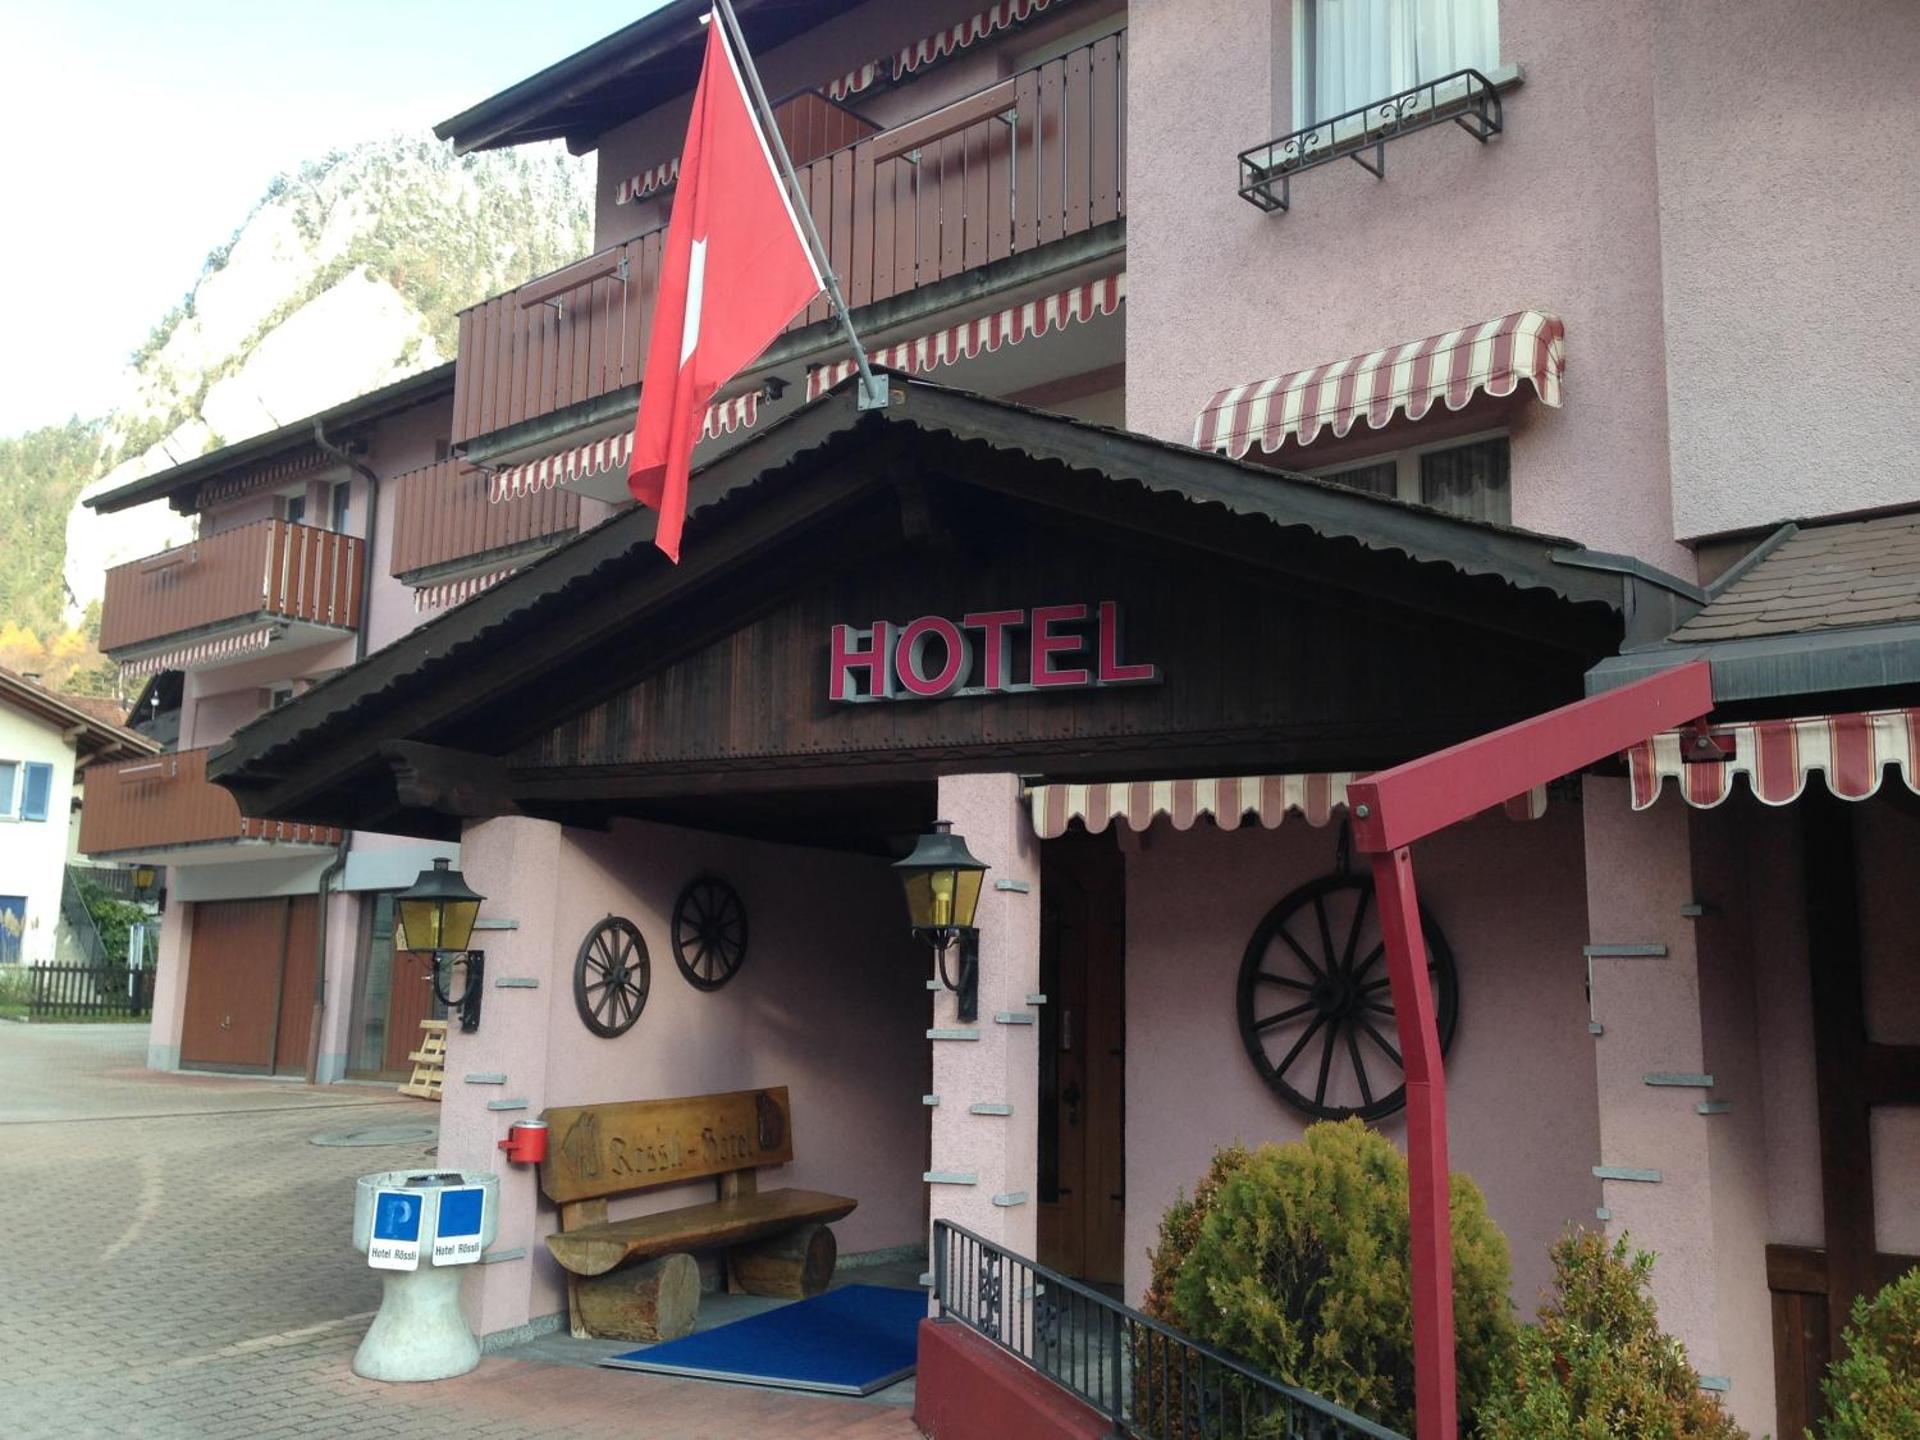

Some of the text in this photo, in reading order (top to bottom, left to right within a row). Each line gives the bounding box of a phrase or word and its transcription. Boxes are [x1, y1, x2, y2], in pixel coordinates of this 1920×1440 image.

[828, 600, 1158, 702] HOTEL
[386, 1199, 412, 1235] P
[371, 1247, 417, 1261] Hotel Rössli
[435, 1242, 480, 1257] Hotel Rössli
